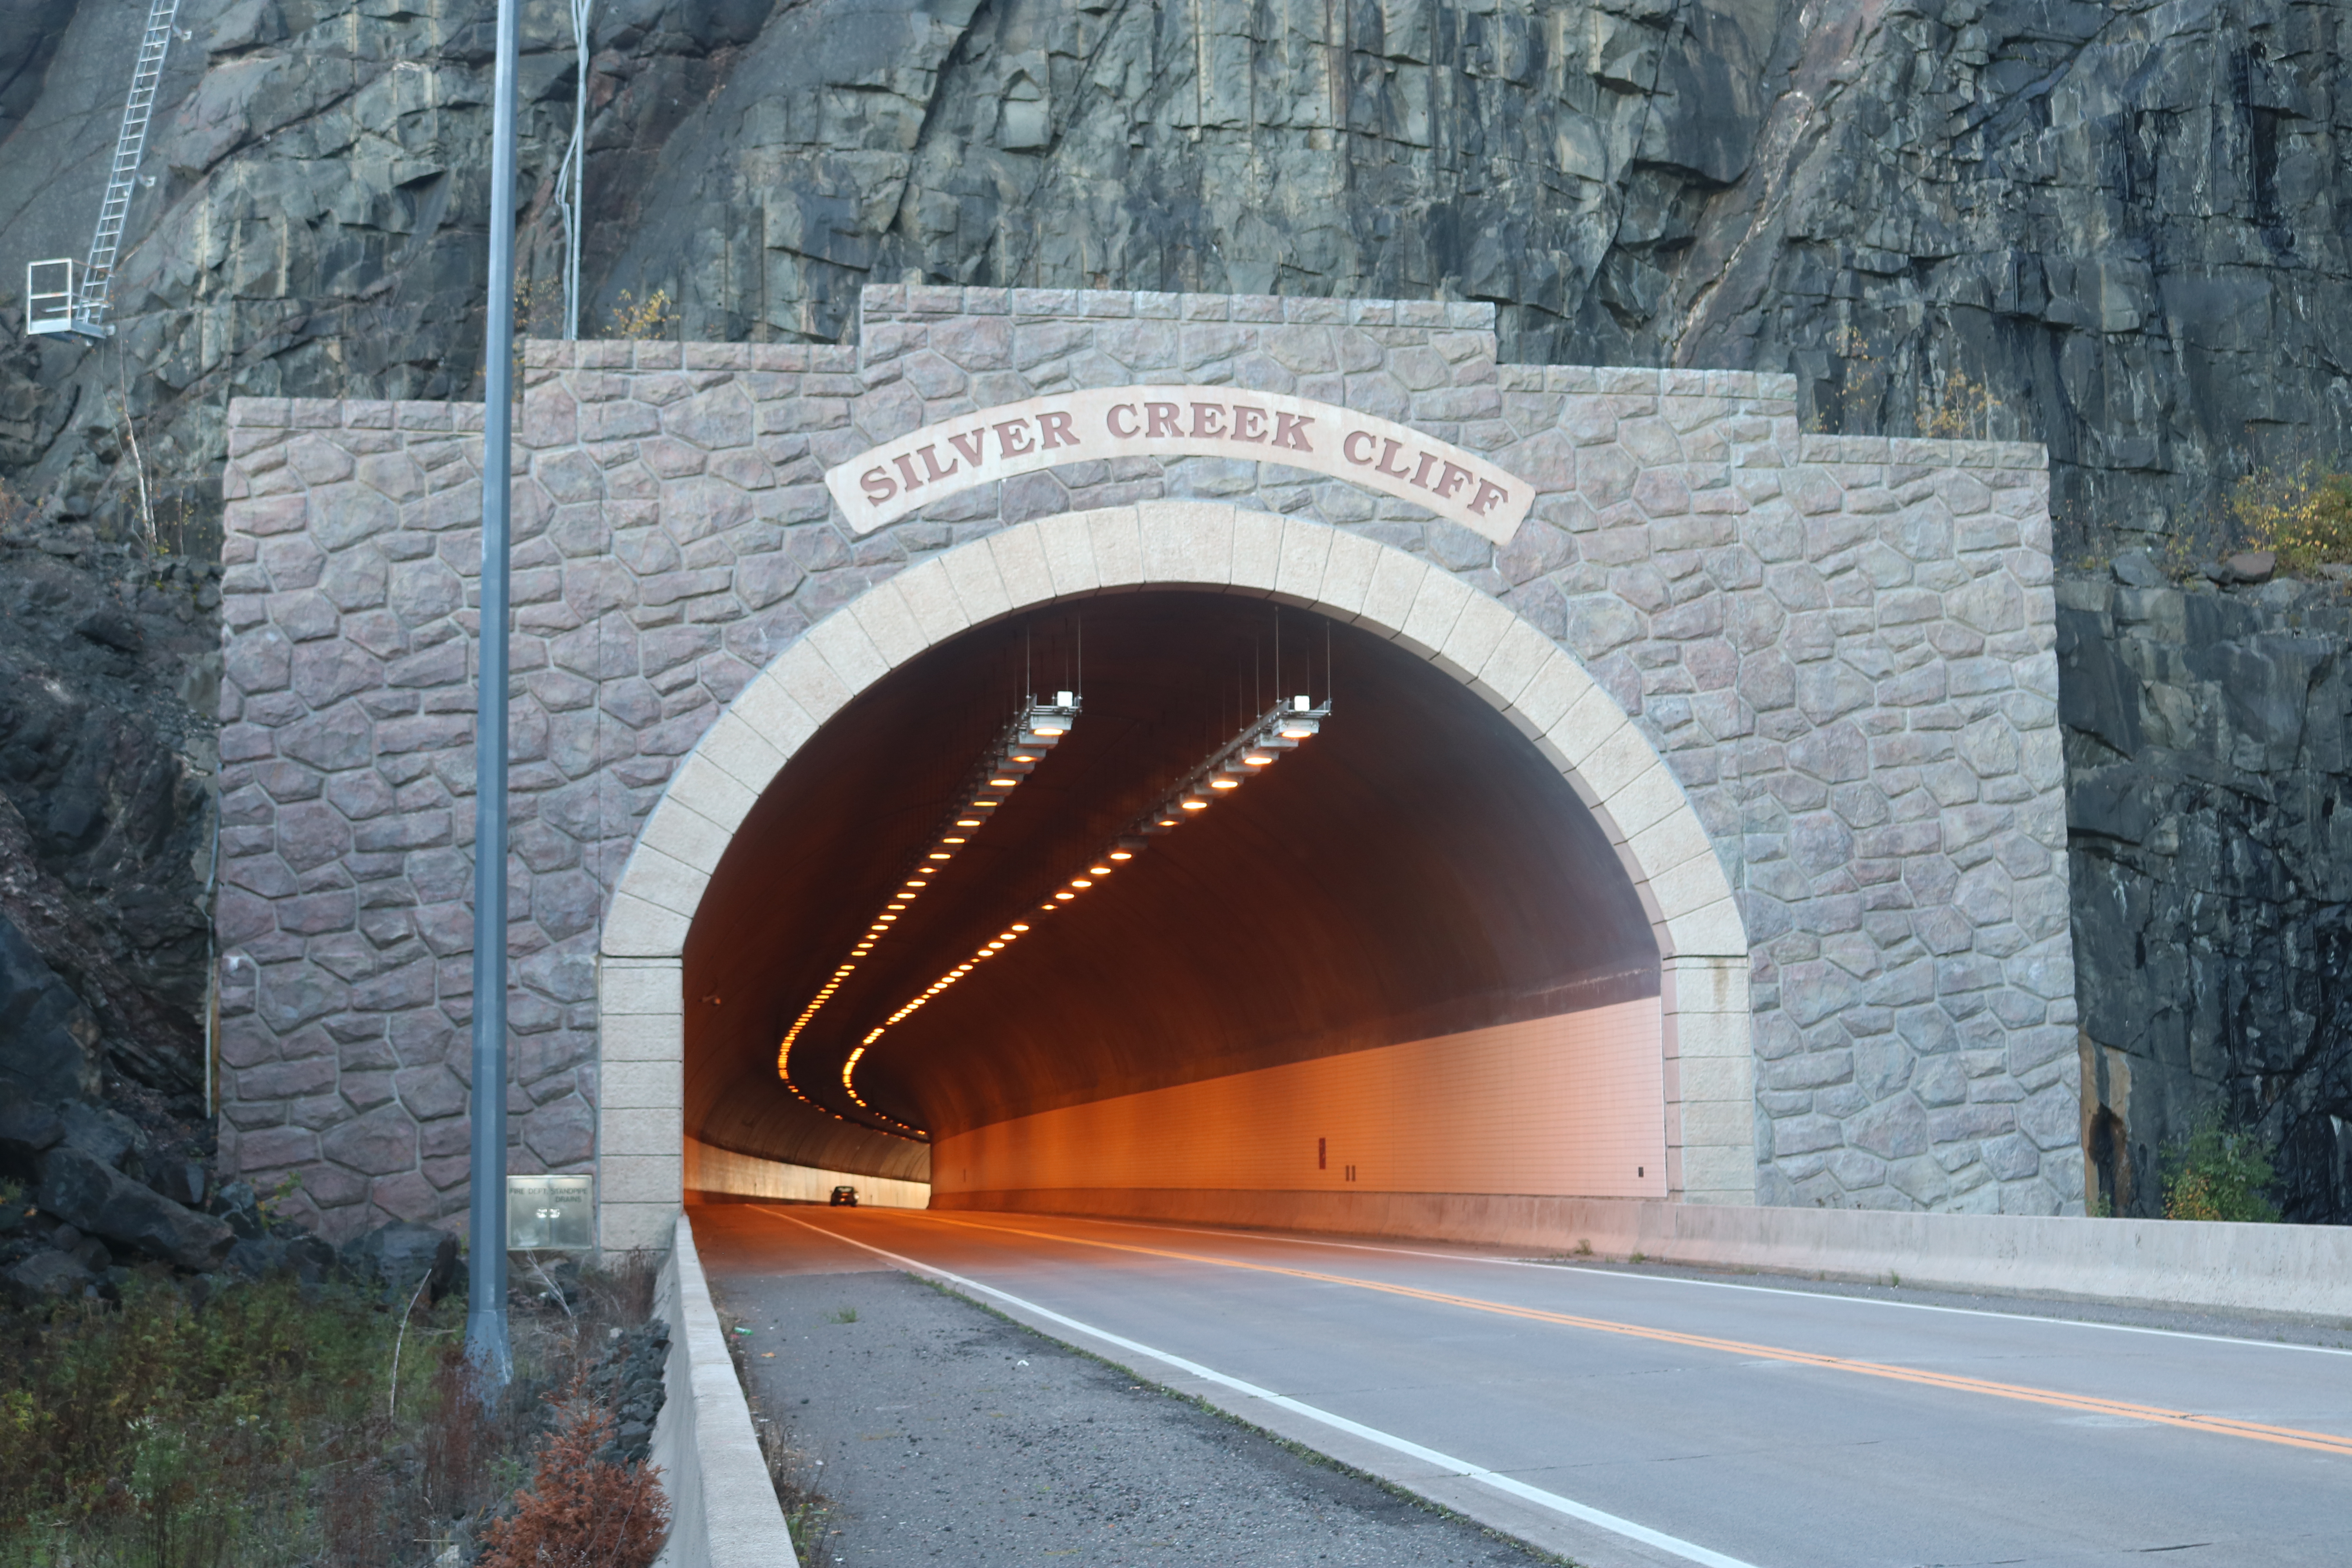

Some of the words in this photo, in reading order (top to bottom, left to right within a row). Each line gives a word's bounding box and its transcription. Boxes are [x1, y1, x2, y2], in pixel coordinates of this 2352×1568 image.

[860, 411, 1080, 507] SILVER
[1107, 402, 1315, 452] CREEK
[1344, 430, 1509, 517] CLIFF
